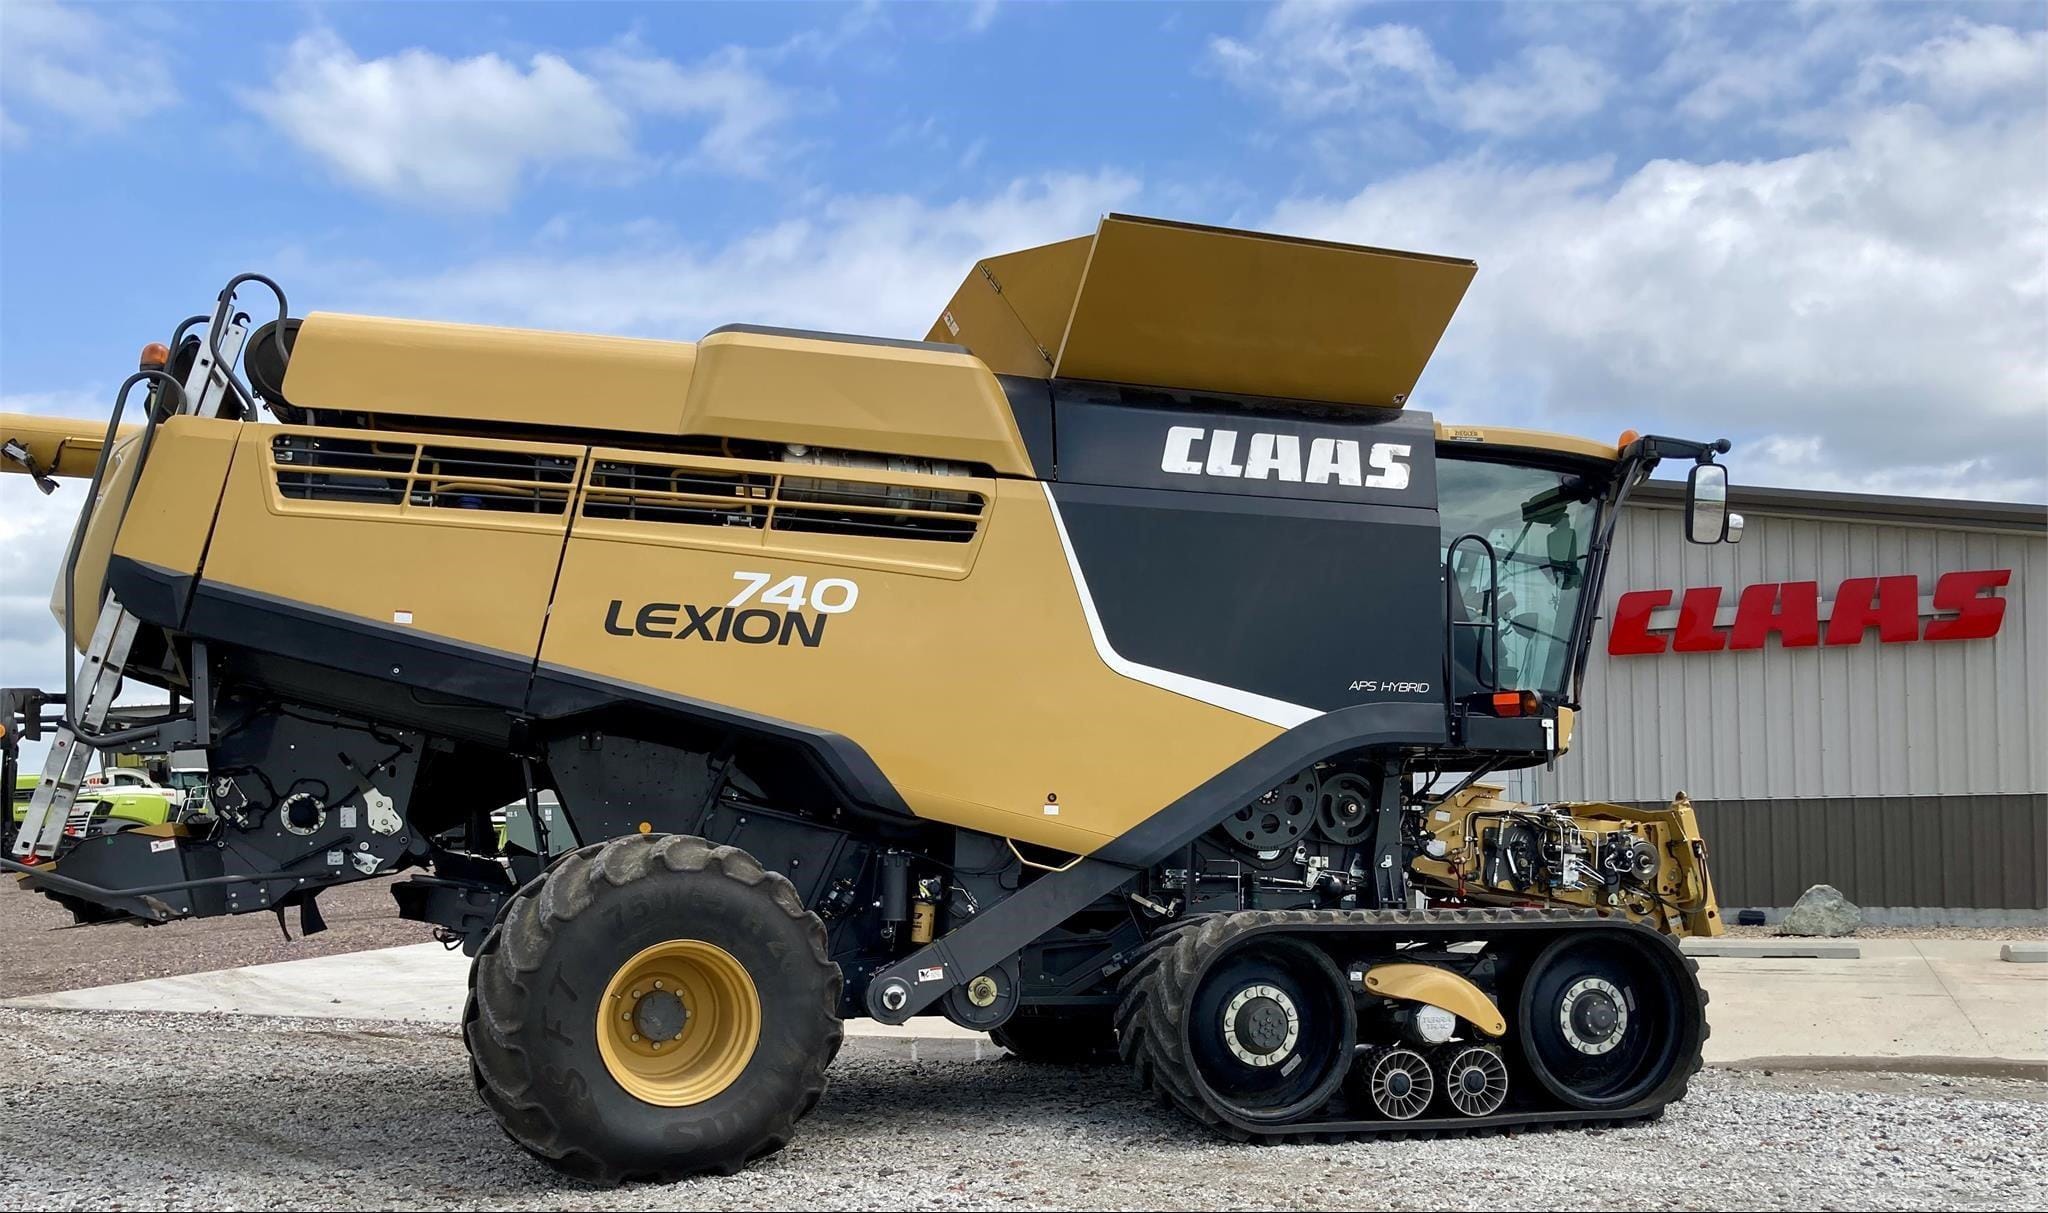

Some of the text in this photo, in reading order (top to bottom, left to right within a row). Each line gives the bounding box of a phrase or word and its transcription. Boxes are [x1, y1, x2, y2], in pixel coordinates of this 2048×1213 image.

[1161, 426, 1411, 490] CLAAS
[727, 571, 859, 614] 740
[1608, 569, 2012, 656] CLAAS
[604, 600, 827, 648] LEXION
[1348, 680, 1430, 693] APS HYBRID
